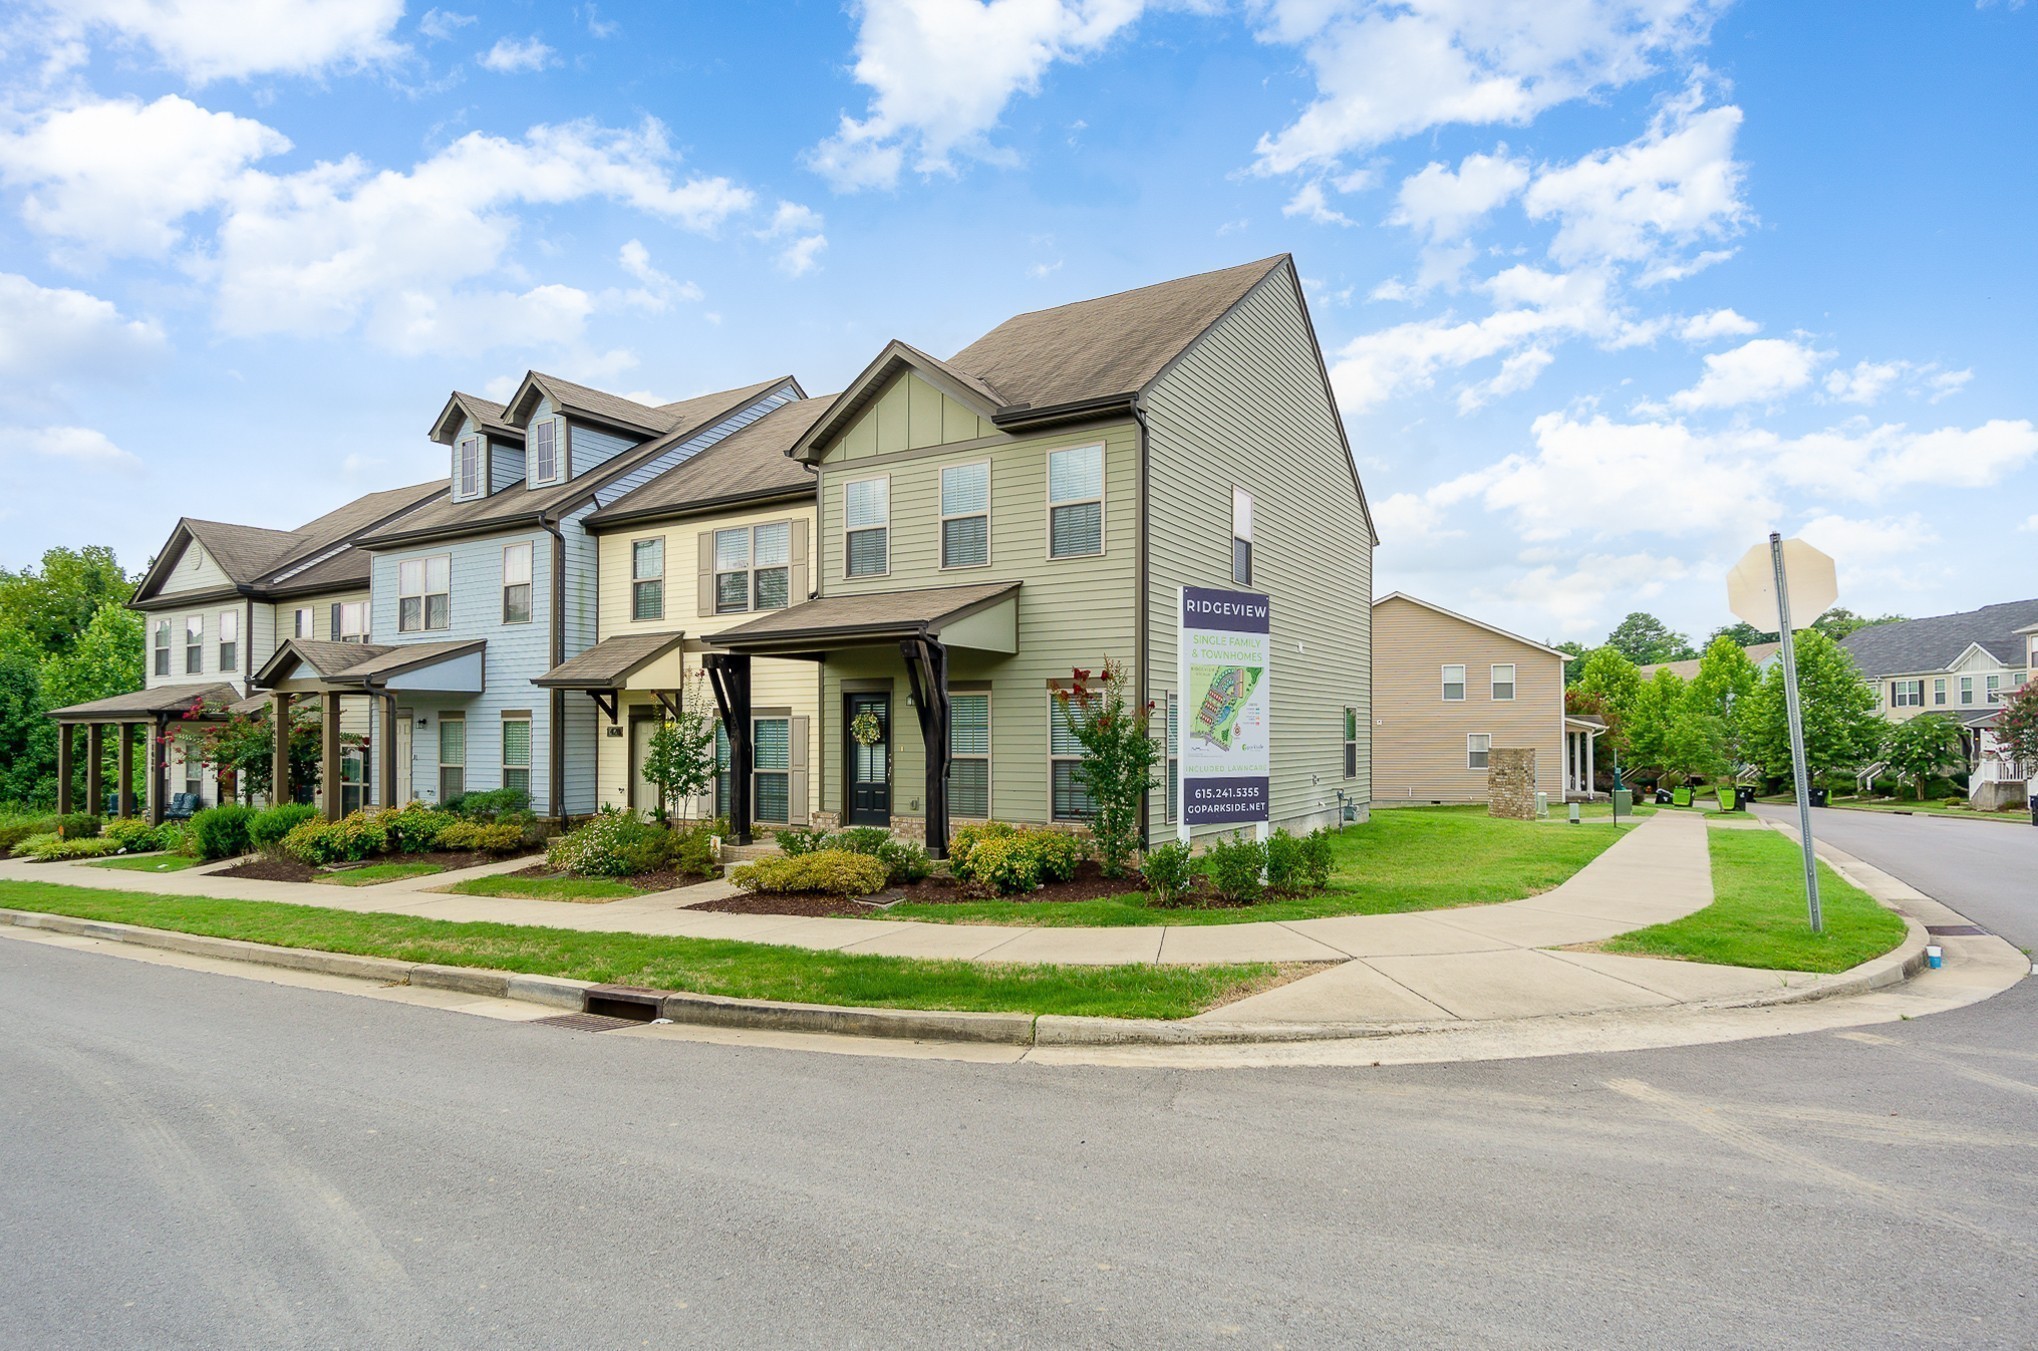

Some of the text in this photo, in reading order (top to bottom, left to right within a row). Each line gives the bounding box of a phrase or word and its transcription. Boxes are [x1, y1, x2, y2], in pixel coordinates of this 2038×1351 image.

[1186, 599, 1267, 618] RIDGEVIEW
[1193, 634, 1261, 648] SINGLE FAMILY
[1192, 649, 1262, 662] & TOWNHOMES
[1186, 764, 1267, 773] INCLUDED LAWNCARE
[1195, 787, 1259, 799] 615.241.5355
[1187, 802, 1266, 814] GOPARKSIDE.NET
